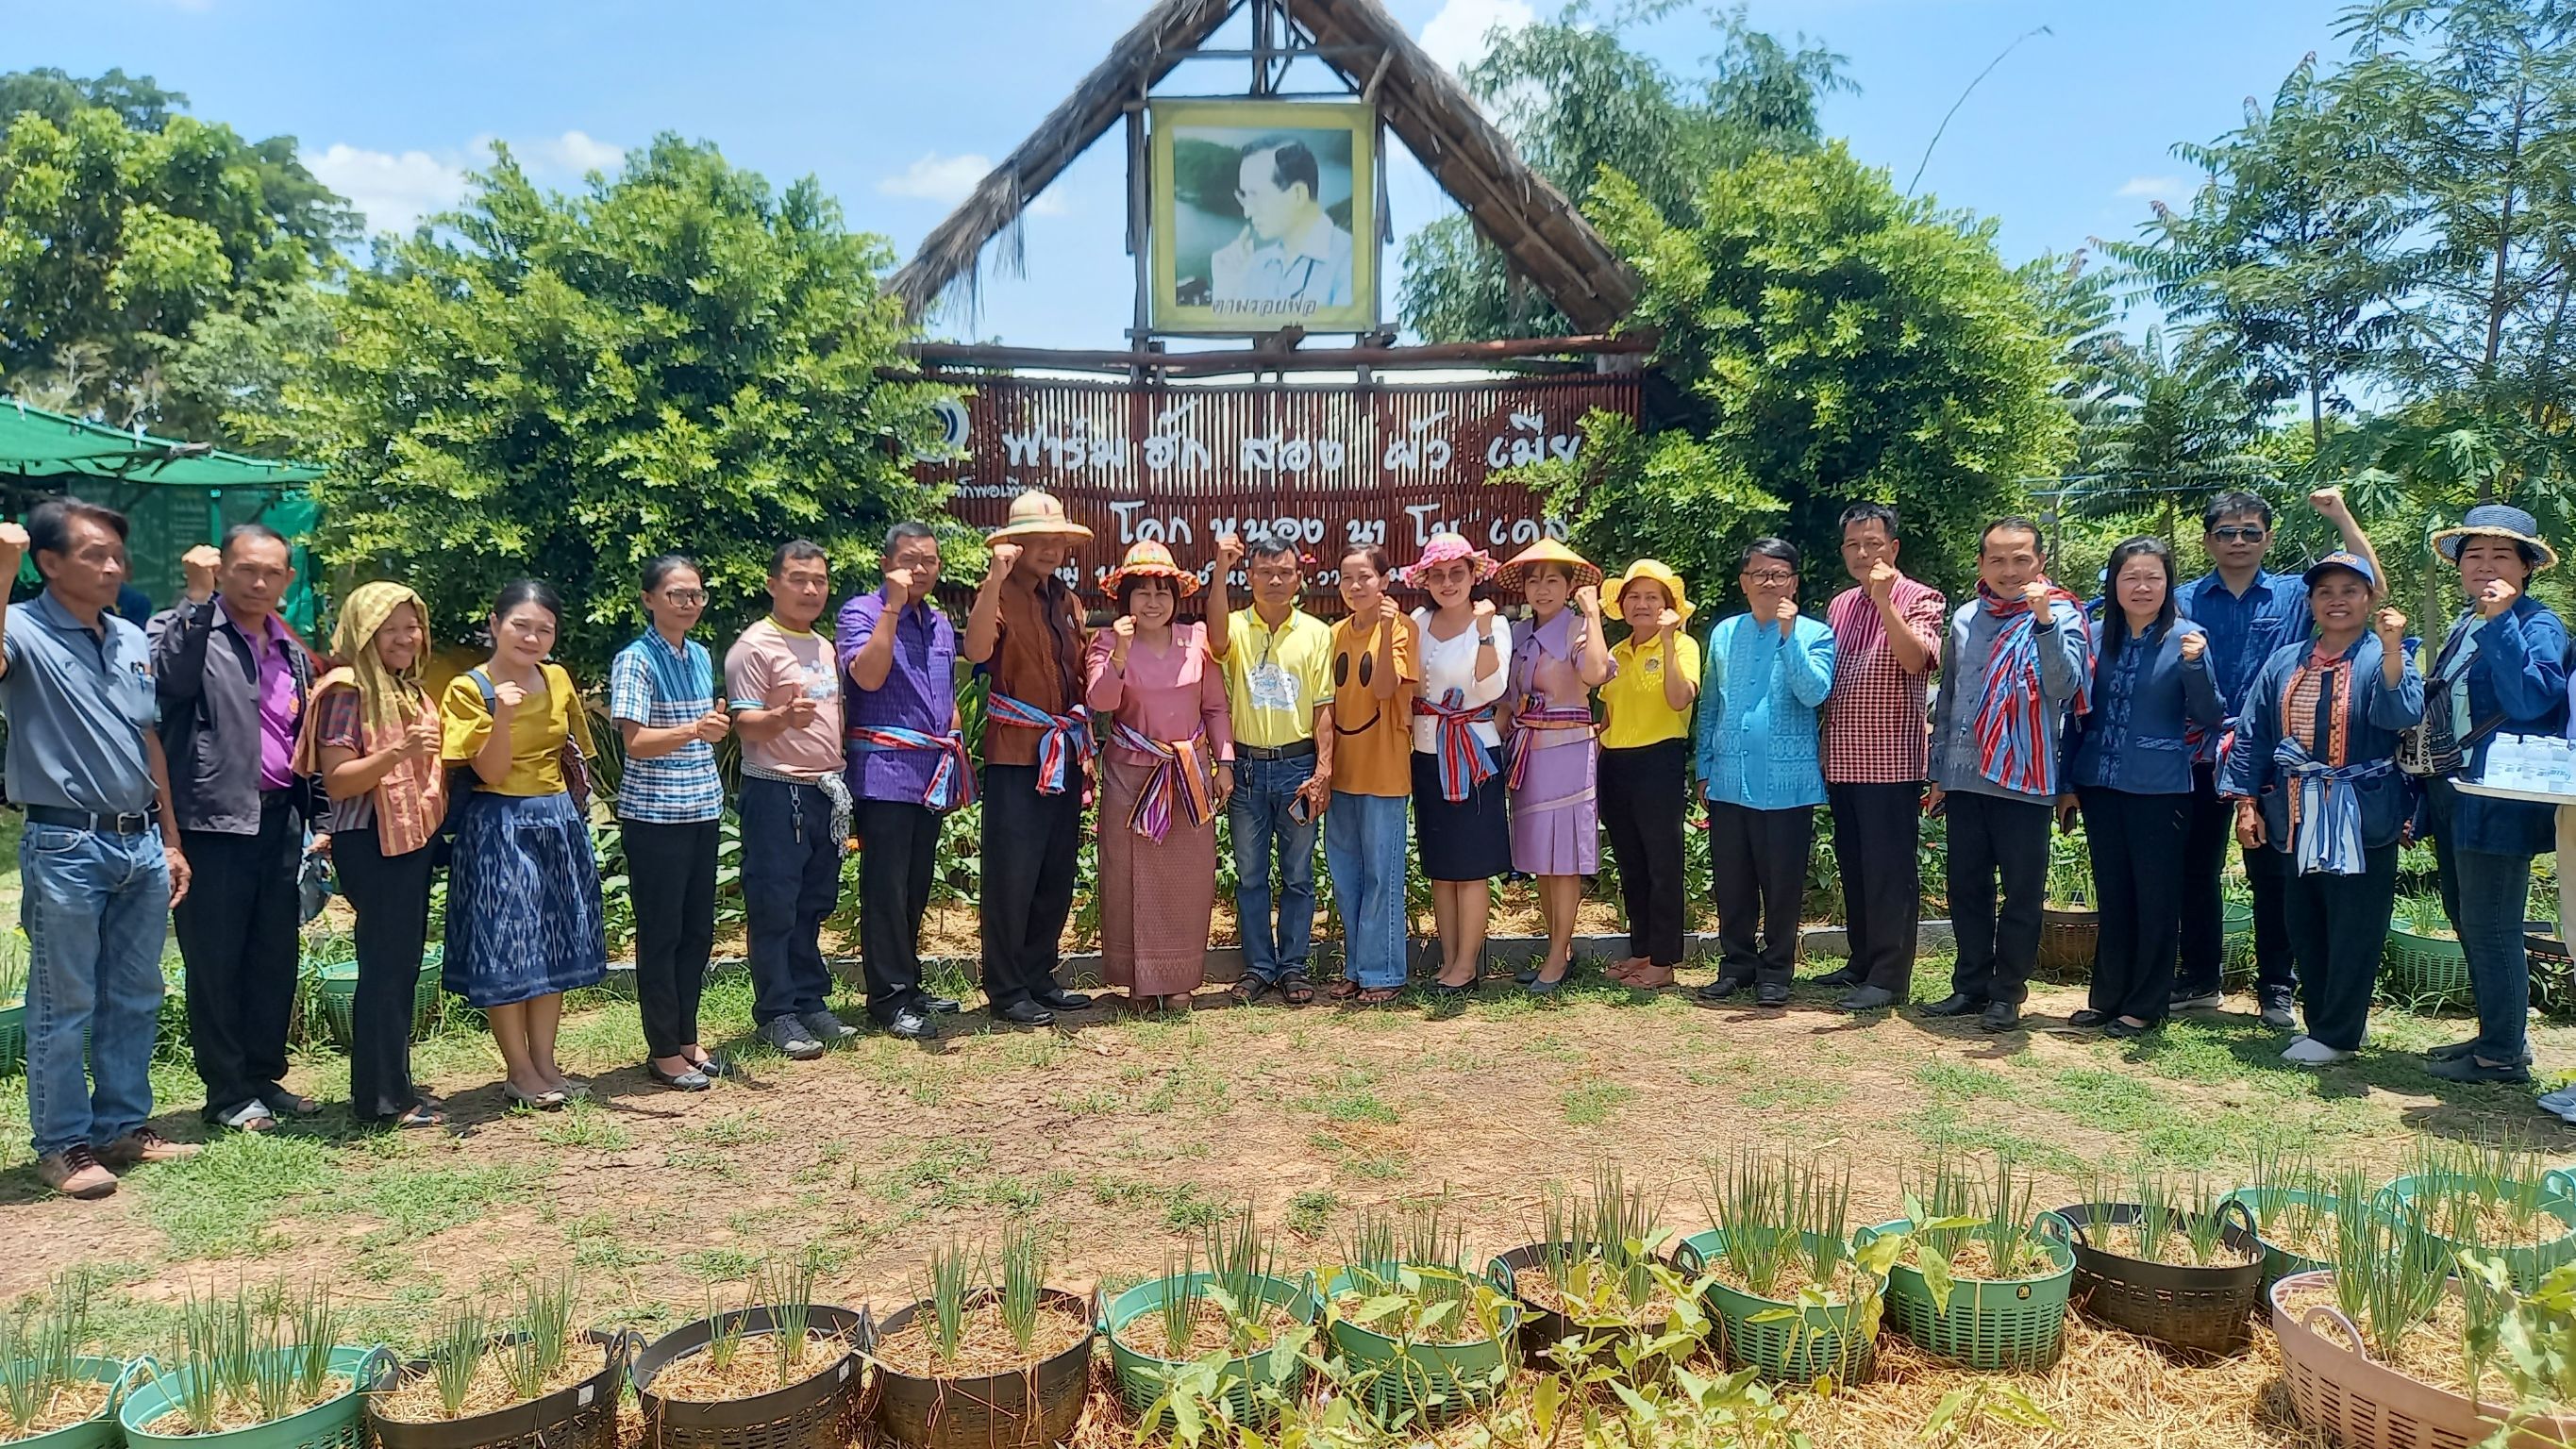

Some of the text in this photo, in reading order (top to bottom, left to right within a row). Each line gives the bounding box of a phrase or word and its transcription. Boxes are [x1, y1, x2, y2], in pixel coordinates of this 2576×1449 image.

[1212, 291, 1318, 316] ตามรอยพ่อ
[1240, 434, 1344, 472] สอง
[1109, 501, 1193, 545] โคก
[1210, 517, 1326, 544] หนอง
[1346, 519, 1387, 545] นา
